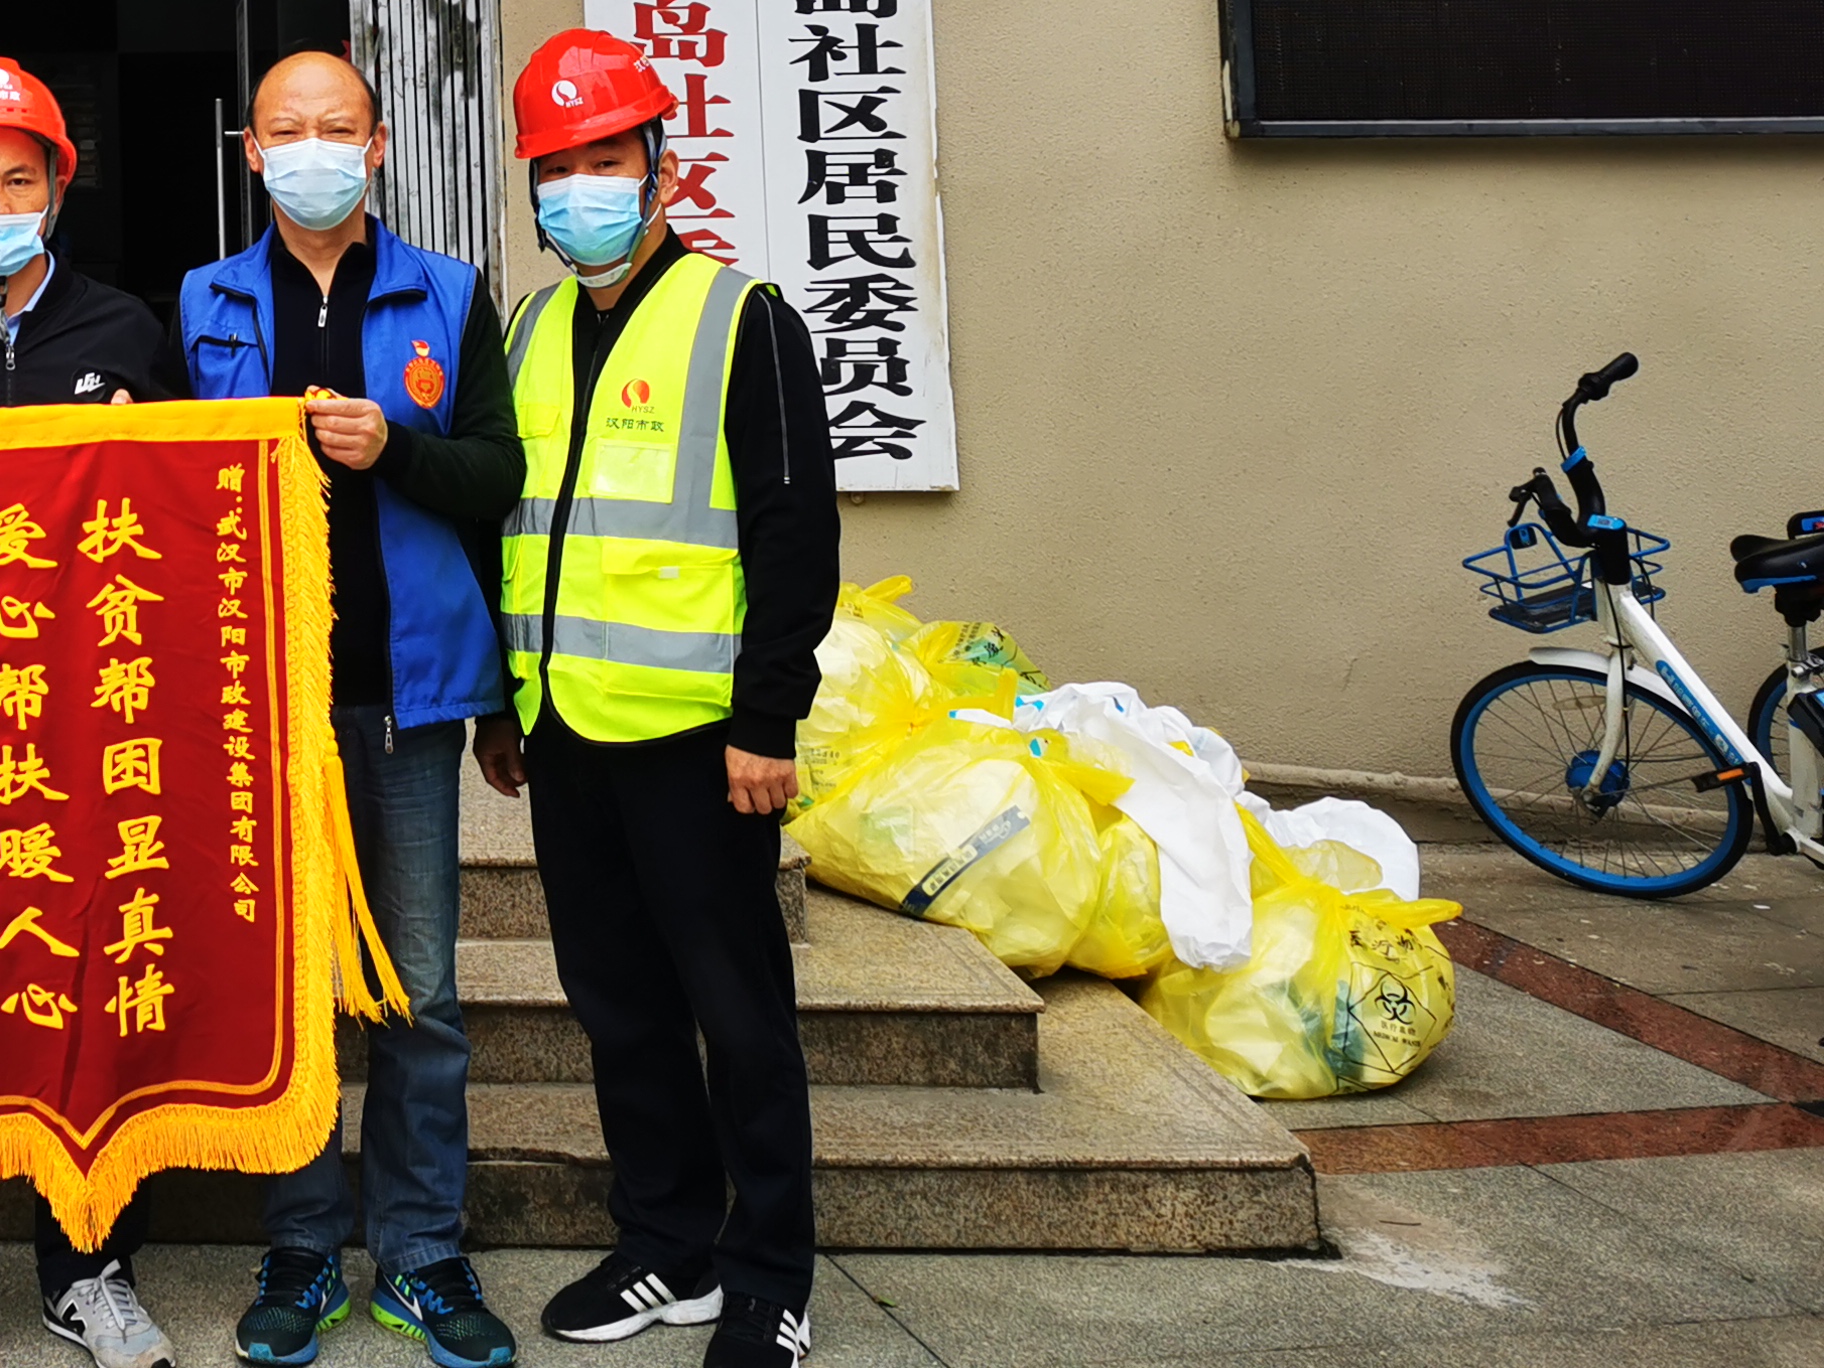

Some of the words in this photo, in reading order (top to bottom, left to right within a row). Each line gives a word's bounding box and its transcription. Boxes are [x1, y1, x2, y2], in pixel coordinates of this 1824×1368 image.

[631, 405, 655, 415] HYSZ
[605, 417, 665, 433] 汉阳市政
[76, 497, 176, 1038] 扶贫帮困显真情
